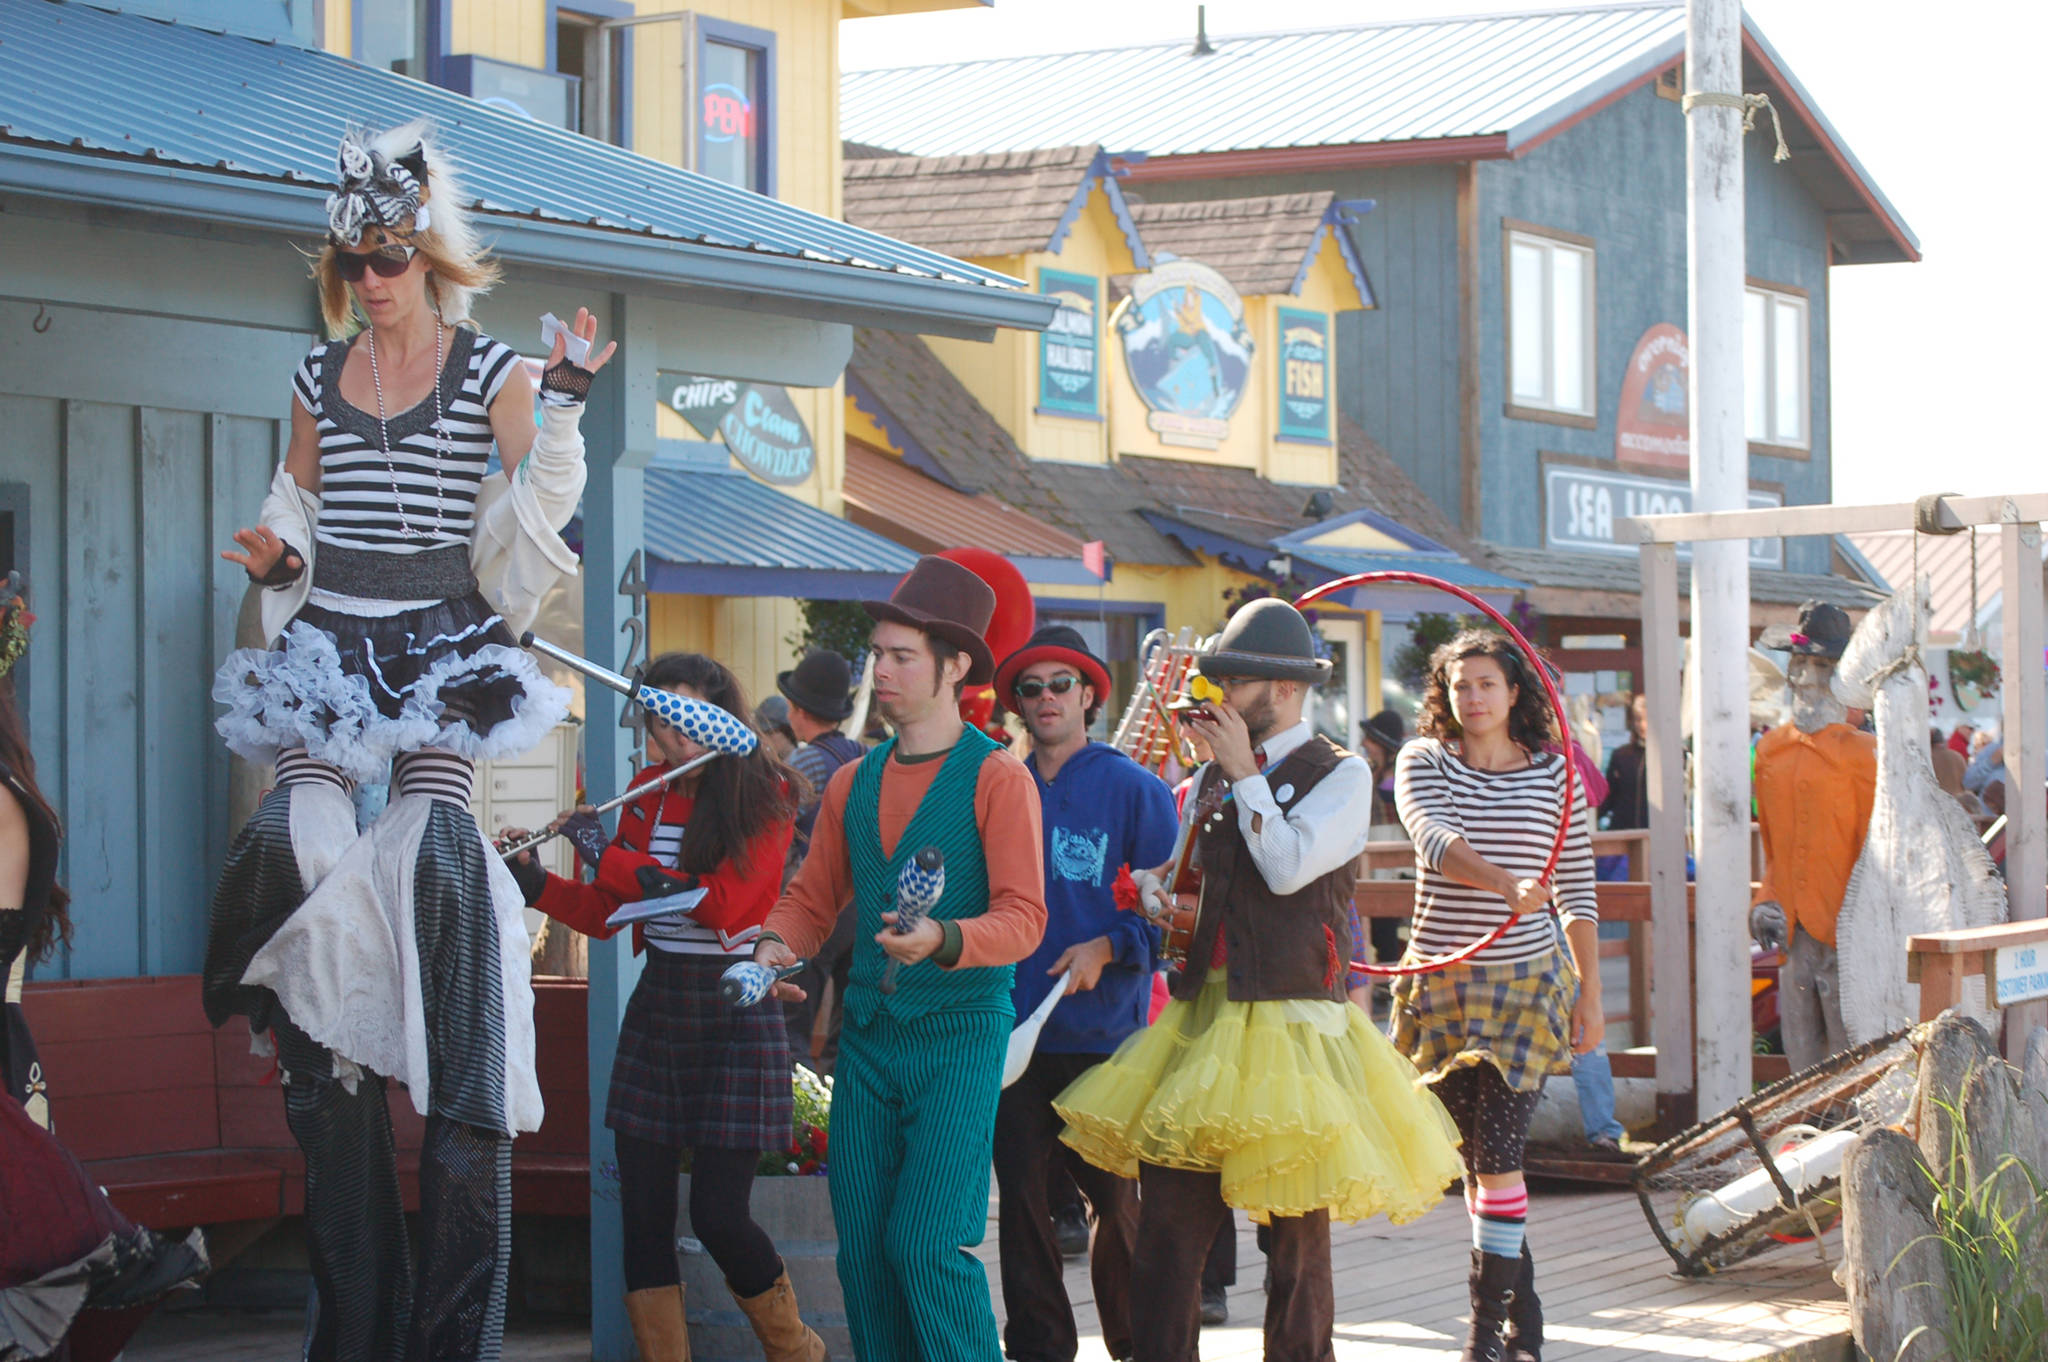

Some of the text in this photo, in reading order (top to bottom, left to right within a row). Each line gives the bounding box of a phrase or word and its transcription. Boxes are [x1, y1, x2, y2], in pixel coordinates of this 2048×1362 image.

[704, 93, 750, 138] PEN
[672, 380, 737, 410] CHIPS
[1286, 359, 1324, 399] FISH
[744, 389, 801, 445] Clam
[725, 413, 813, 478] CHOWDER
[1567, 482, 1613, 539] SEA
